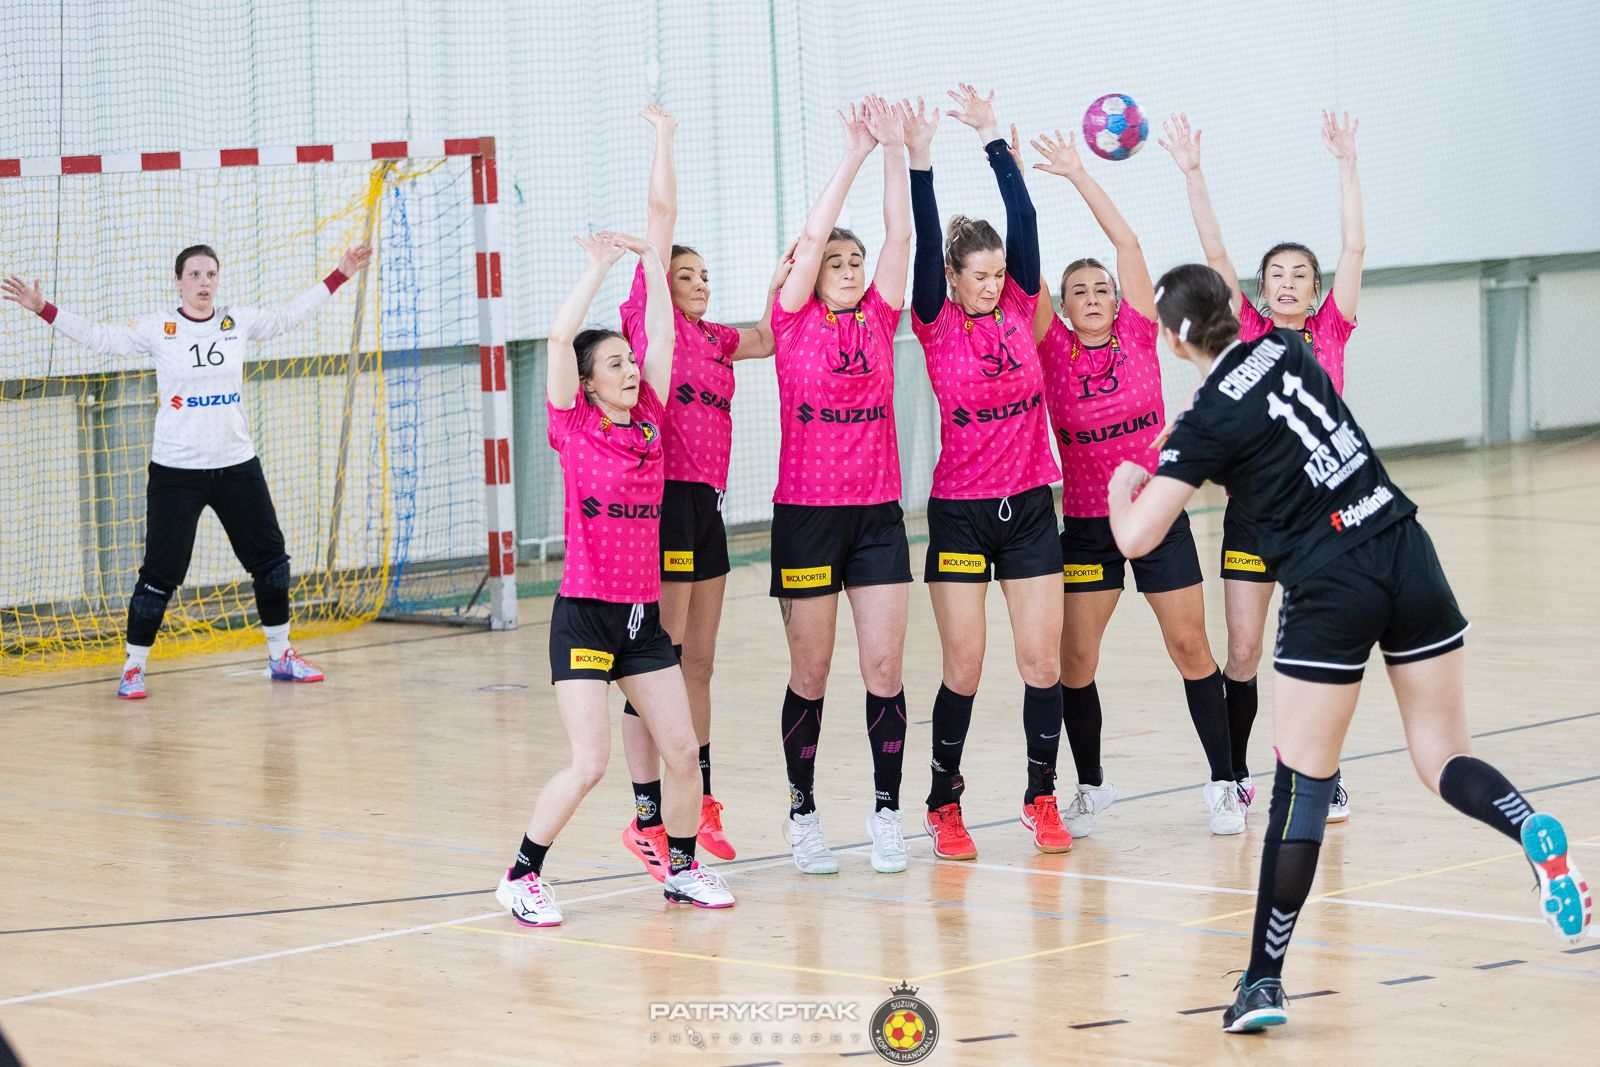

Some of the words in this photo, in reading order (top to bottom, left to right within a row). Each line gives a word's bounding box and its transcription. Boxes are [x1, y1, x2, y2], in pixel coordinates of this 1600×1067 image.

[189, 342, 224, 368] 16
[831, 349, 872, 375] 21
[981, 343, 1022, 378] 31
[820, 404, 888, 425] SUZUK
[976, 391, 1042, 424] SUZUK
[1266, 370, 1338, 452] 11
[1075, 411, 1159, 445] SUZUKI
[1303, 444, 1340, 488] AZS
[607, 503, 662, 519] SUZU
[946, 559, 982, 568] KOLPORTER
[789, 573, 827, 582] KOLPORTER
